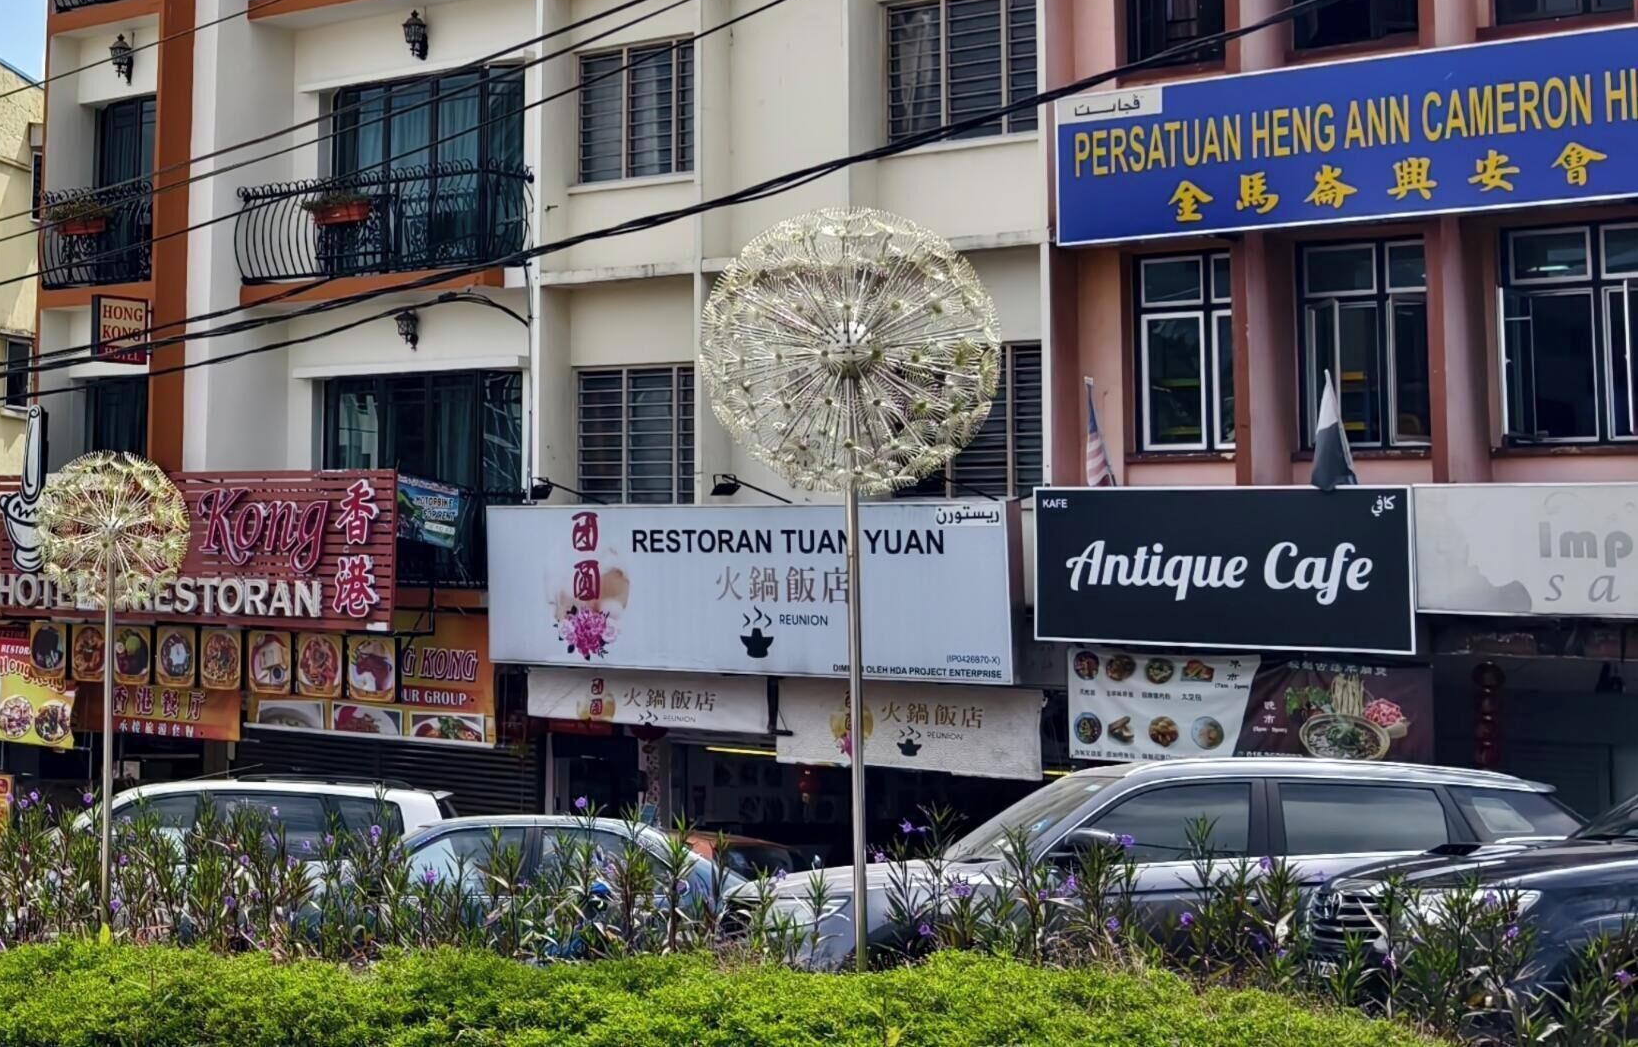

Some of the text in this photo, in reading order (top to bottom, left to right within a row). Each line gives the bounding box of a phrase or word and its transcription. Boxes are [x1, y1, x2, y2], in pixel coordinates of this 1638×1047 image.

[1074, 113, 1242, 178] PERSATUAN
[1251, 103, 1336, 159] HENG
[1343, 93, 1410, 149] ANN
[1422, 73, 1593, 142] CAMERON
[102, 304, 143, 322] HONG
[102, 324, 141, 342] KONG
[1042, 499, 1068, 508] KAFE
[197, 486, 329, 574] Kong
[632, 529, 945, 555] RESTORAN TUAN YUAN
[333, 478, 380, 618] 香港
[715, 565, 850, 605] 火鍋飯店
[1065, 540, 1373, 605] Antique Cafe
[778, 613, 829, 627] REUNION
[0, 644, 31, 656] RESTOR
[419, 646, 480, 682] KONG
[866, 666, 888, 675] OLEH
[889, 667, 907, 676] HDA
[908, 667, 947, 678] PROJECT
[948, 668, 1002, 679] ENTERPRISE
[423, 689, 467, 706] GROUP
[880, 701, 984, 729] 火鍋飯店
